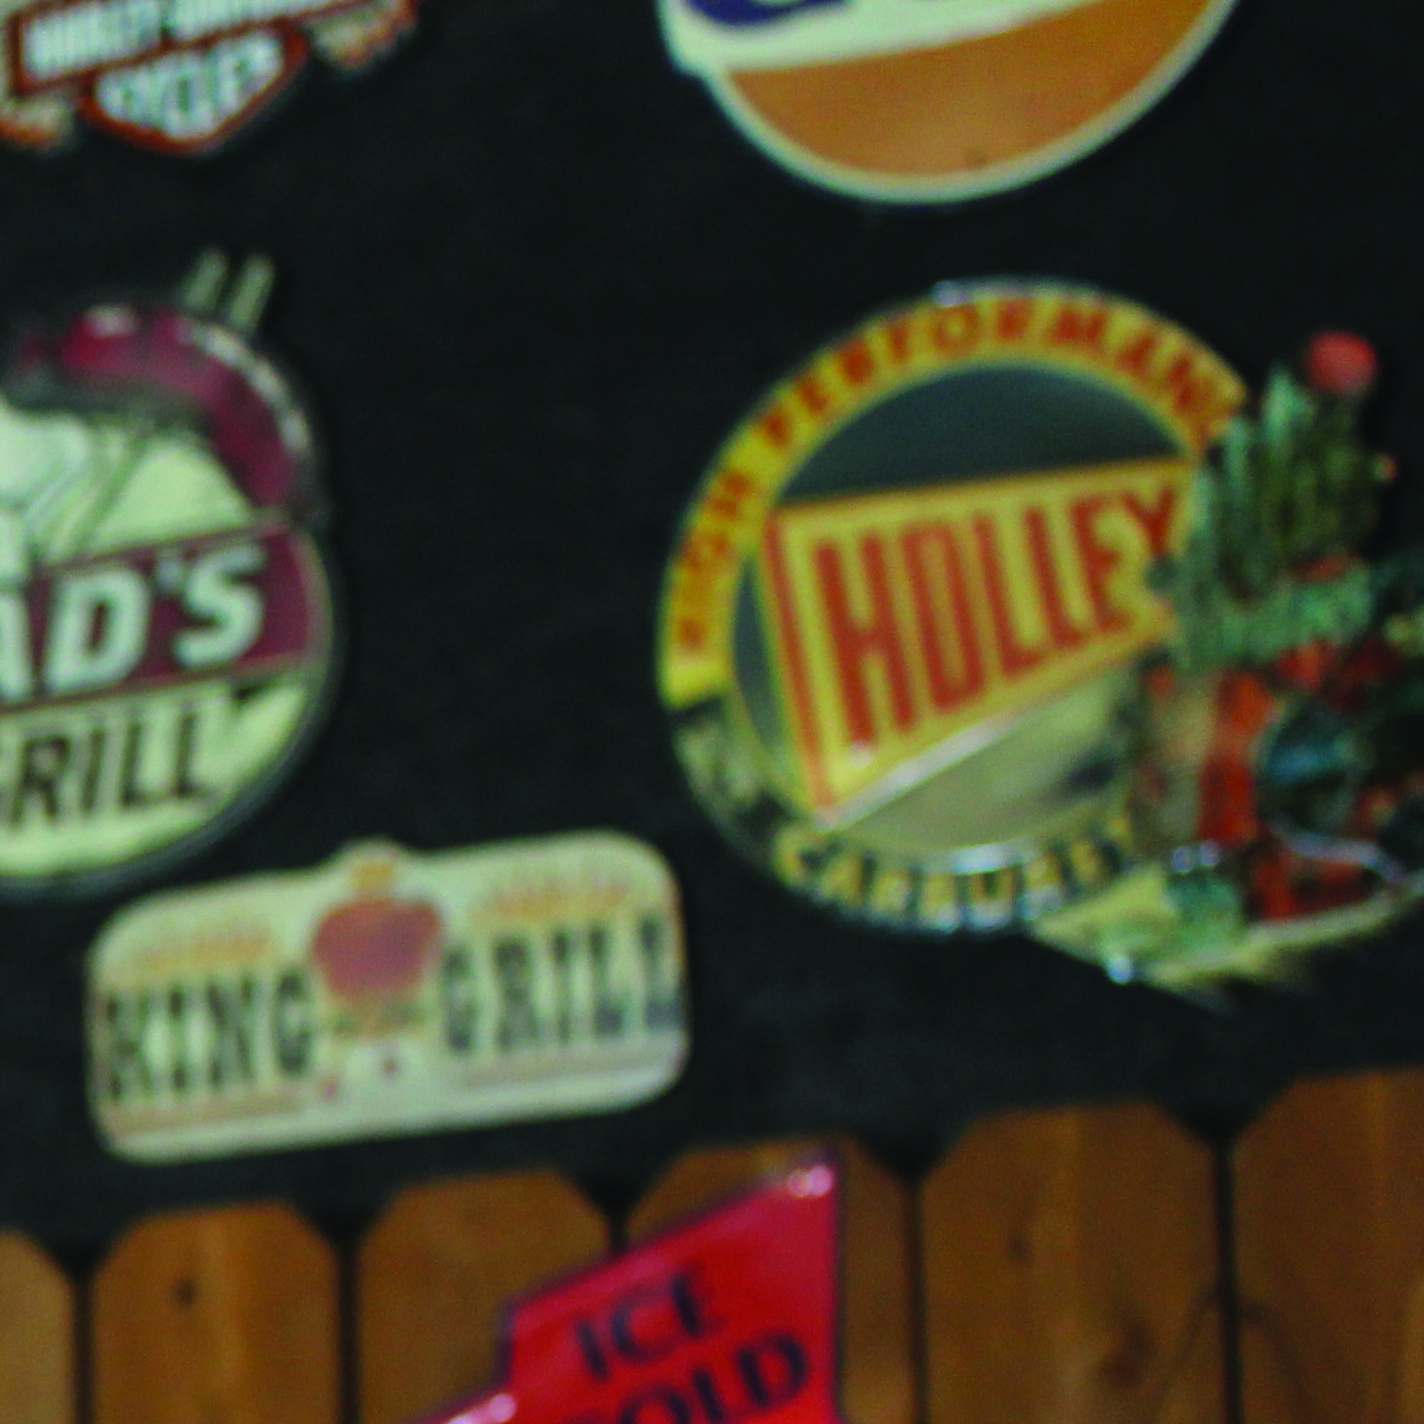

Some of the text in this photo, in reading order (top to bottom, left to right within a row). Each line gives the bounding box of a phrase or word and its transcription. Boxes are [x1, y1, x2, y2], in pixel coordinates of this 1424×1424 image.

[813, 484, 1176, 752] HOLLEY
[442, 912, 682, 1058] GRILL
[572, 1268, 724, 1384] ICE
